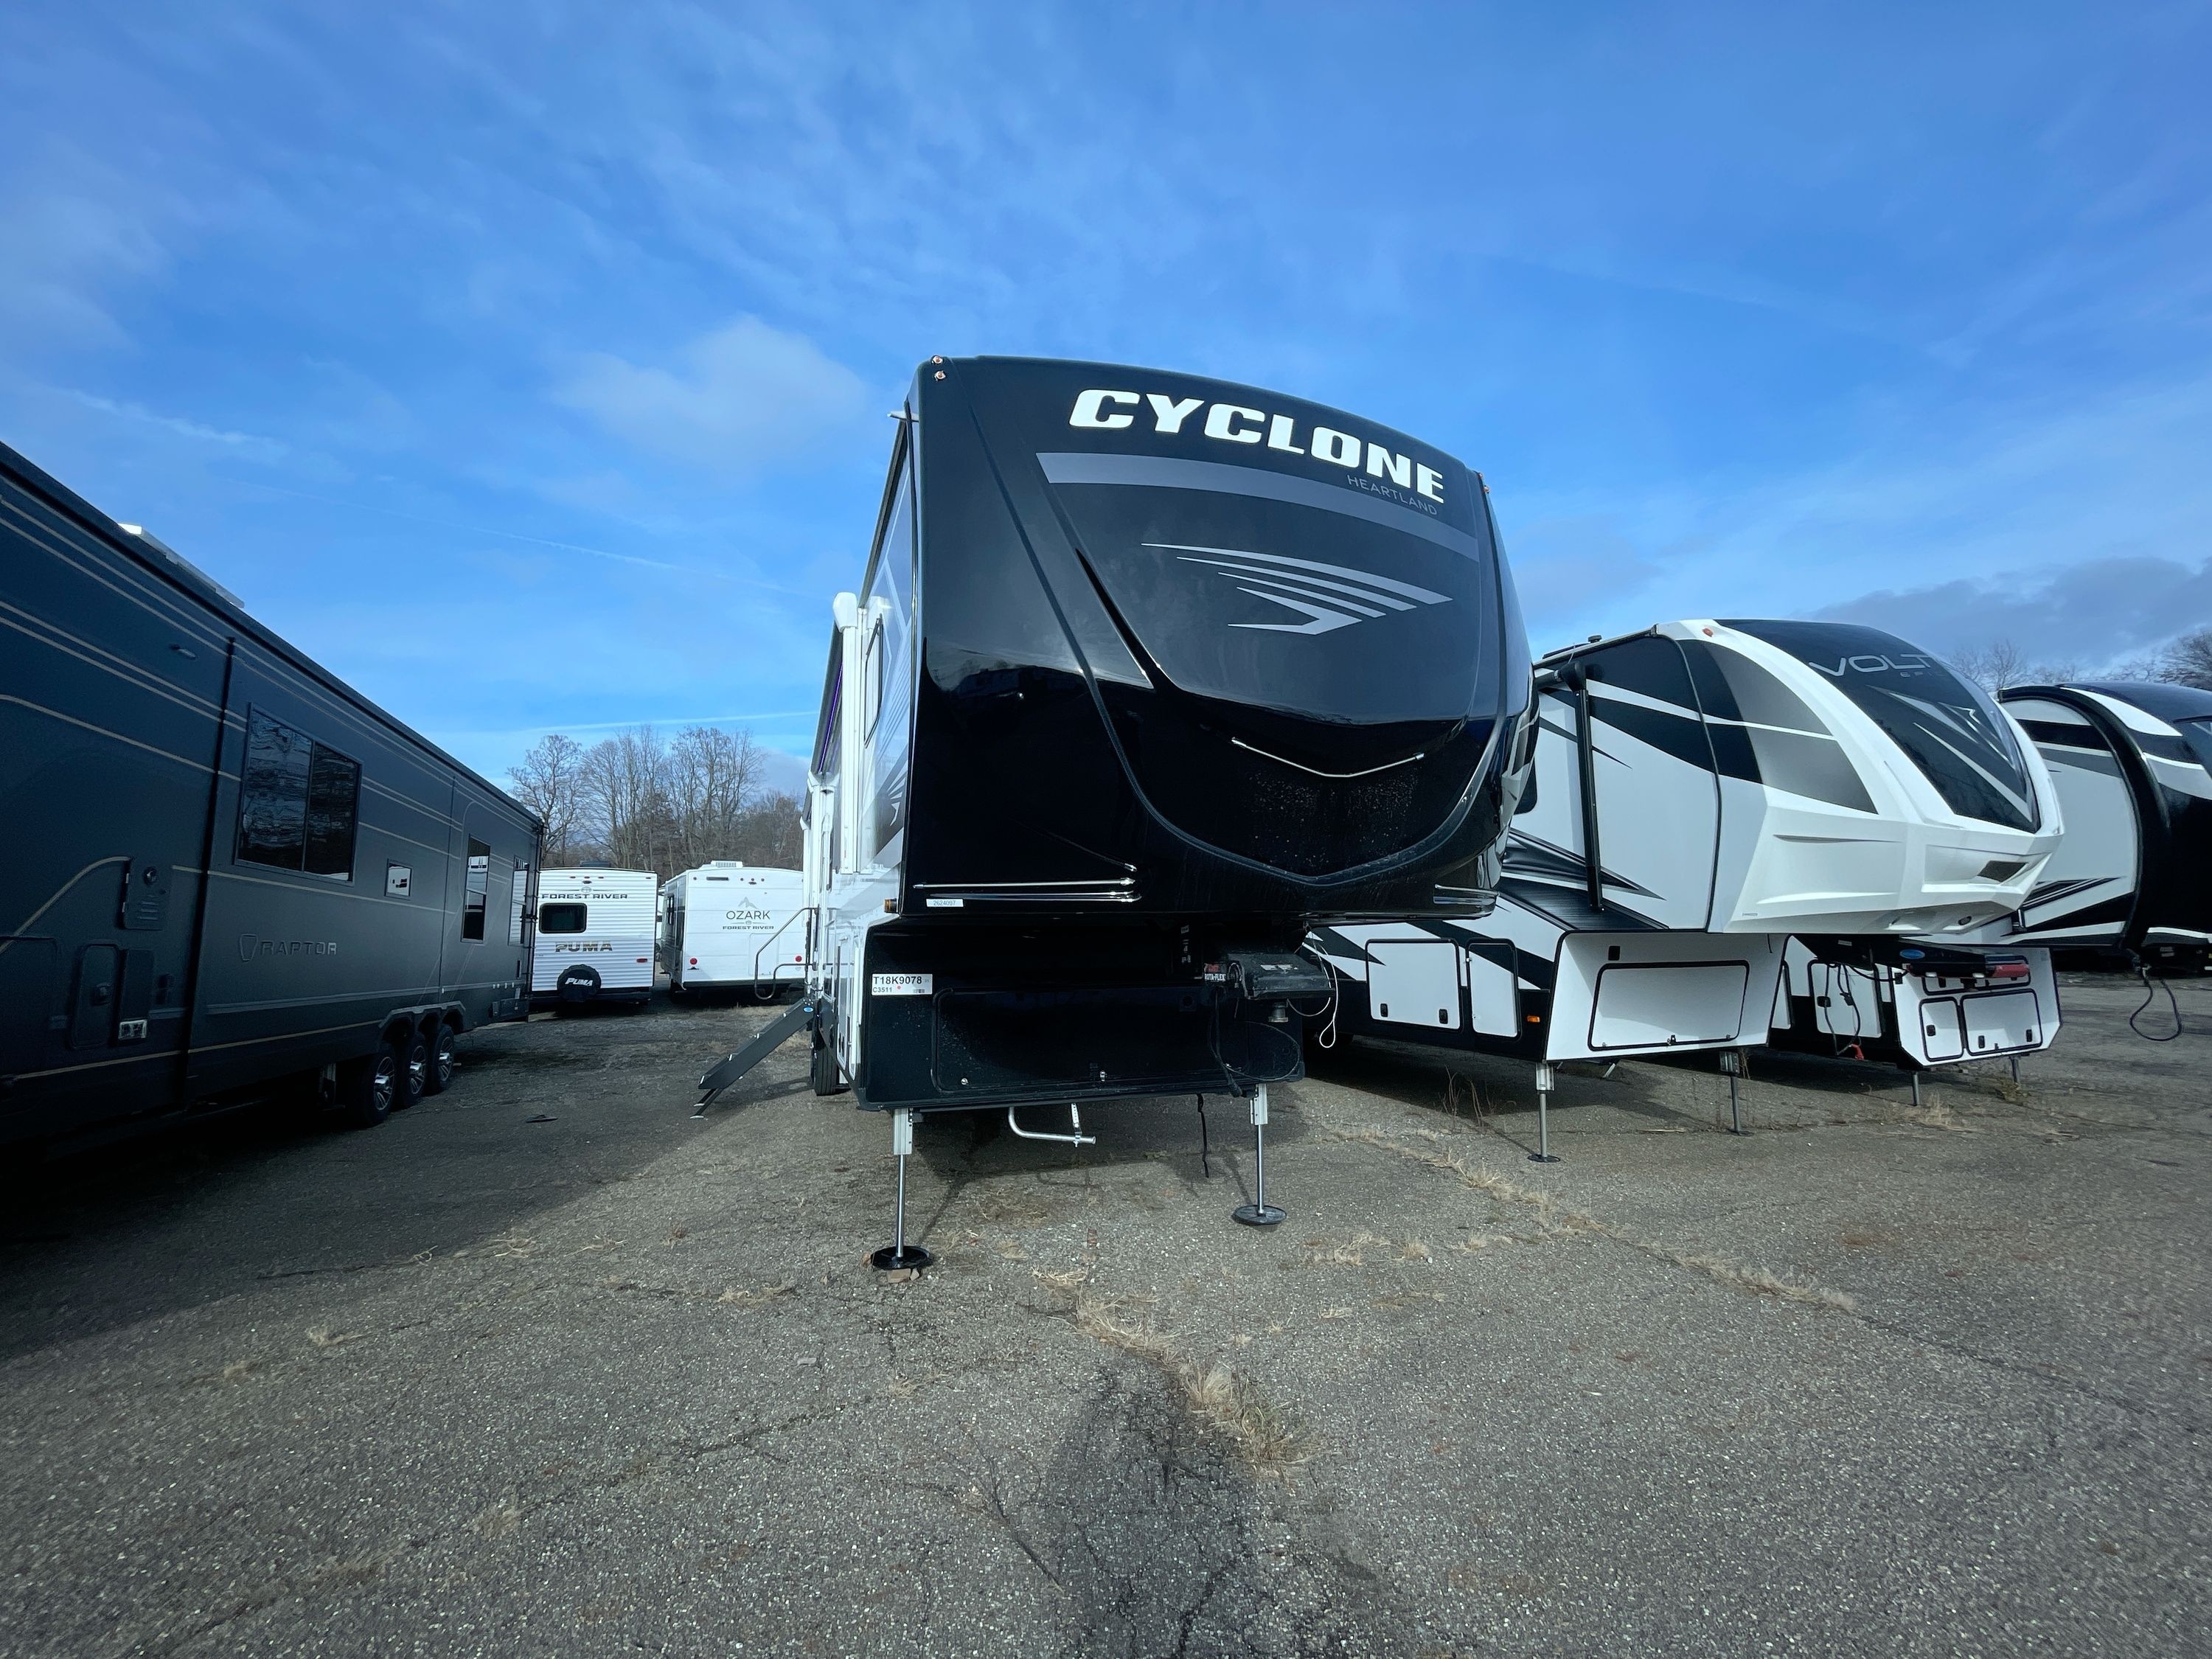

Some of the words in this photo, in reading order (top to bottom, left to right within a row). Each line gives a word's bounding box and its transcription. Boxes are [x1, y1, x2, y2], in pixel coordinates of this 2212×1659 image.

[1068, 389, 1444, 504] CYCLONE
[1346, 474, 1438, 515] HEARTLAND
[1809, 653, 1931, 676] VOLT
[726, 910, 771, 920] OZARK
[260, 940, 337, 956] RAPTOR
[554, 941, 613, 953] PUMA
[565, 978, 594, 987] PUMA
[873, 975, 922, 985] T18K9078
